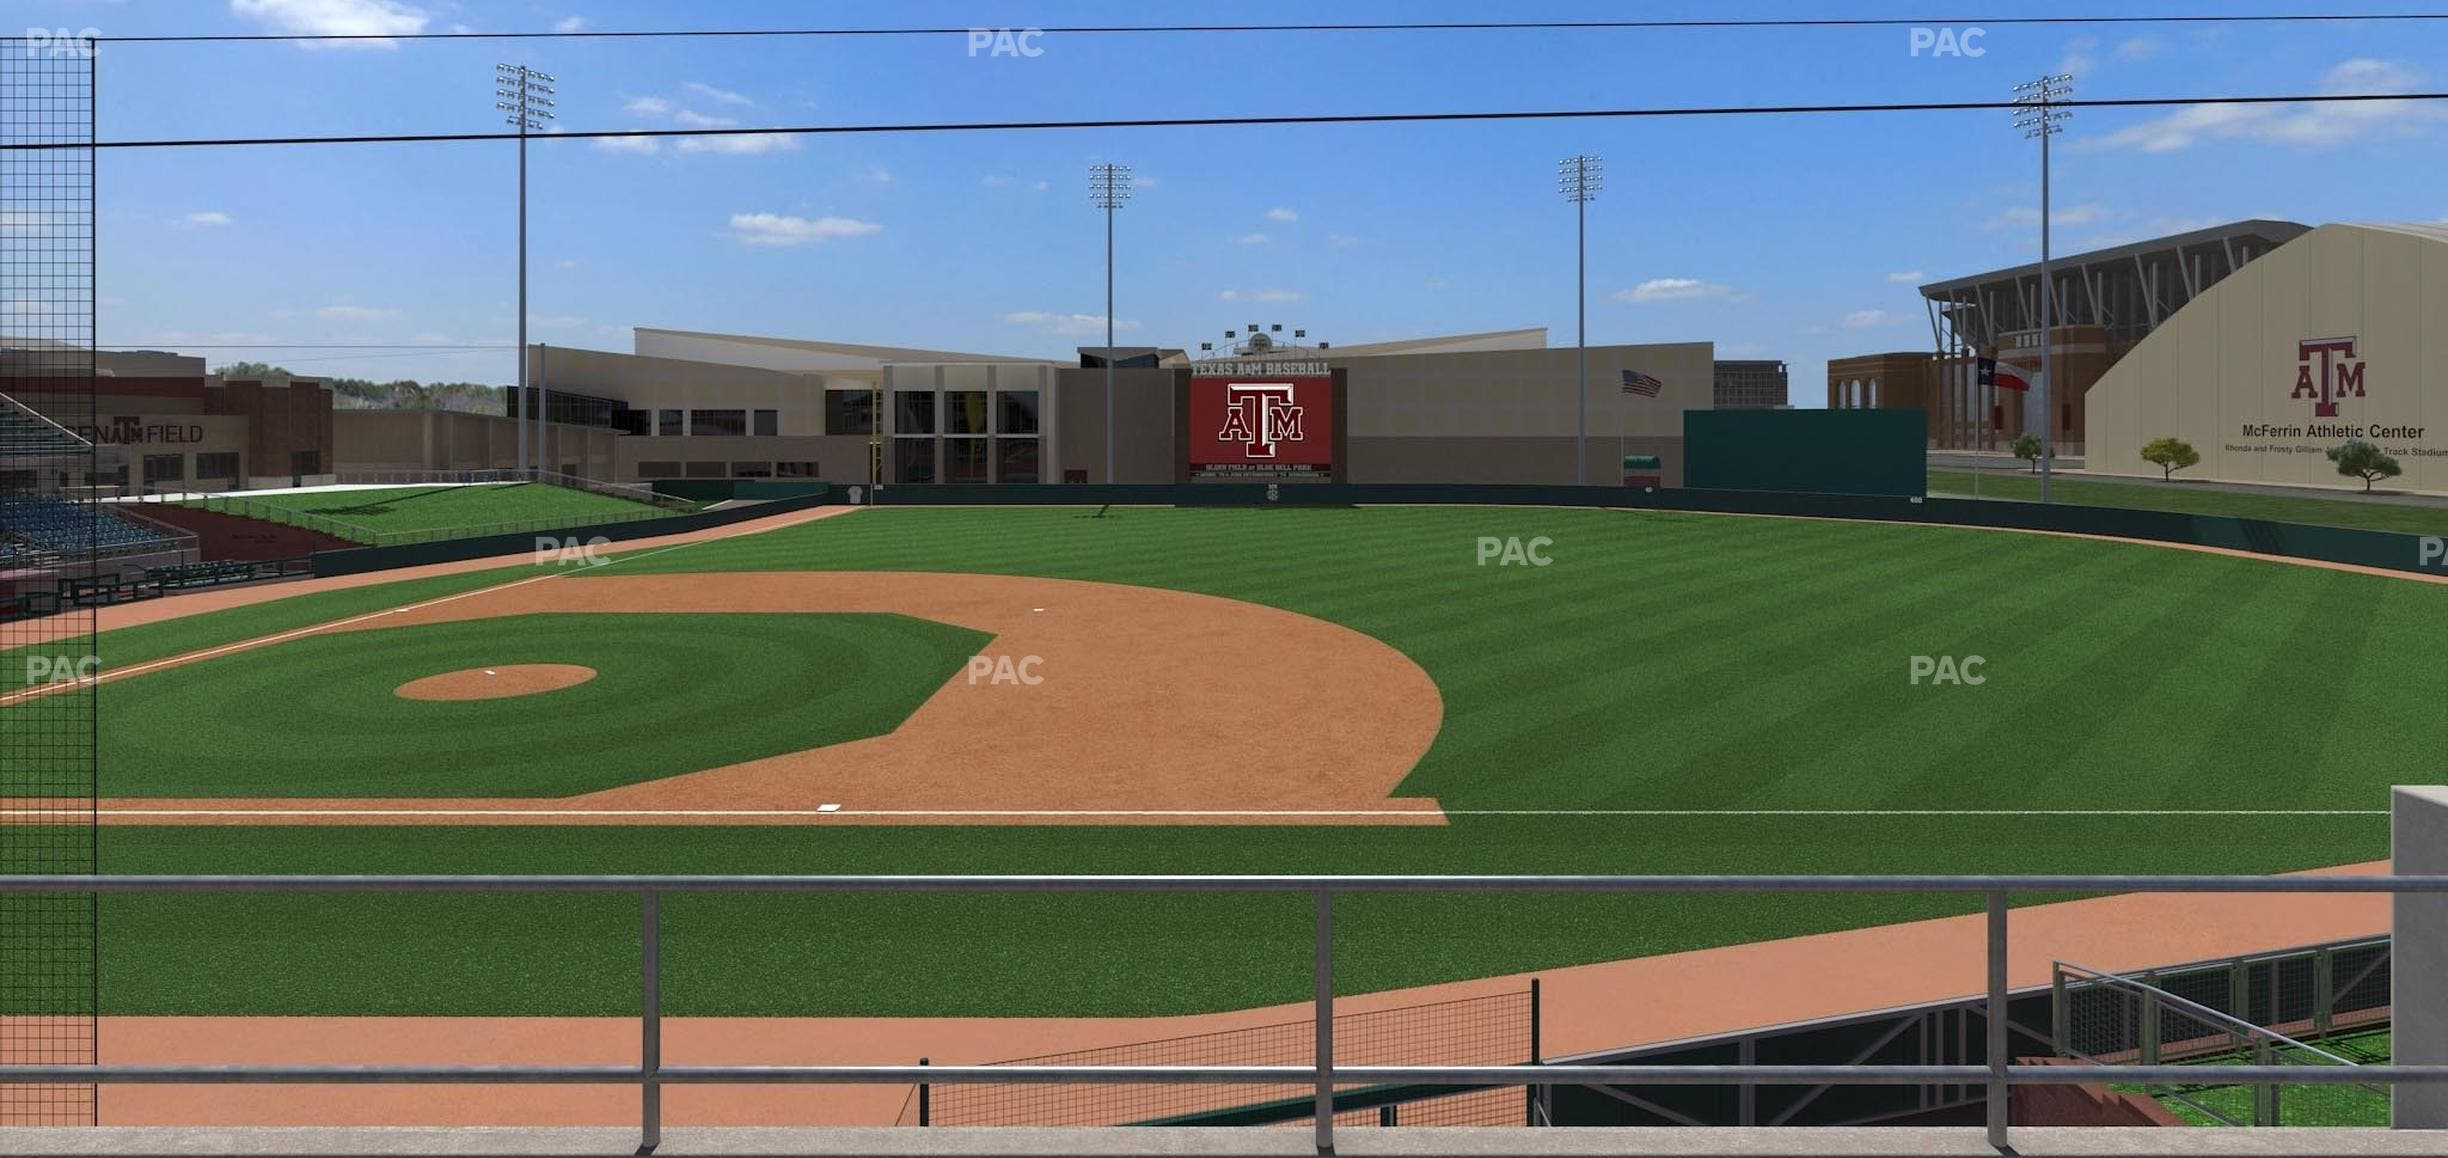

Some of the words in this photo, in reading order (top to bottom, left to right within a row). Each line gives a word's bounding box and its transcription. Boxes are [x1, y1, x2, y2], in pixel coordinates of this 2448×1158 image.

[1192, 363, 1233, 375] TEXAS
[1265, 362, 1331, 375] BASEBALL
[147, 425, 203, 443] FIELD
[2242, 424, 2301, 437] McFerrin
[2306, 424, 2363, 438] Athletic
[2369, 424, 2425, 439] Center
[2225, 444, 2252, 452] Rhonda
[2254, 444, 2267, 452] and
[2269, 444, 2293, 454] Frosty
[2383, 447, 2409, 456] Track
